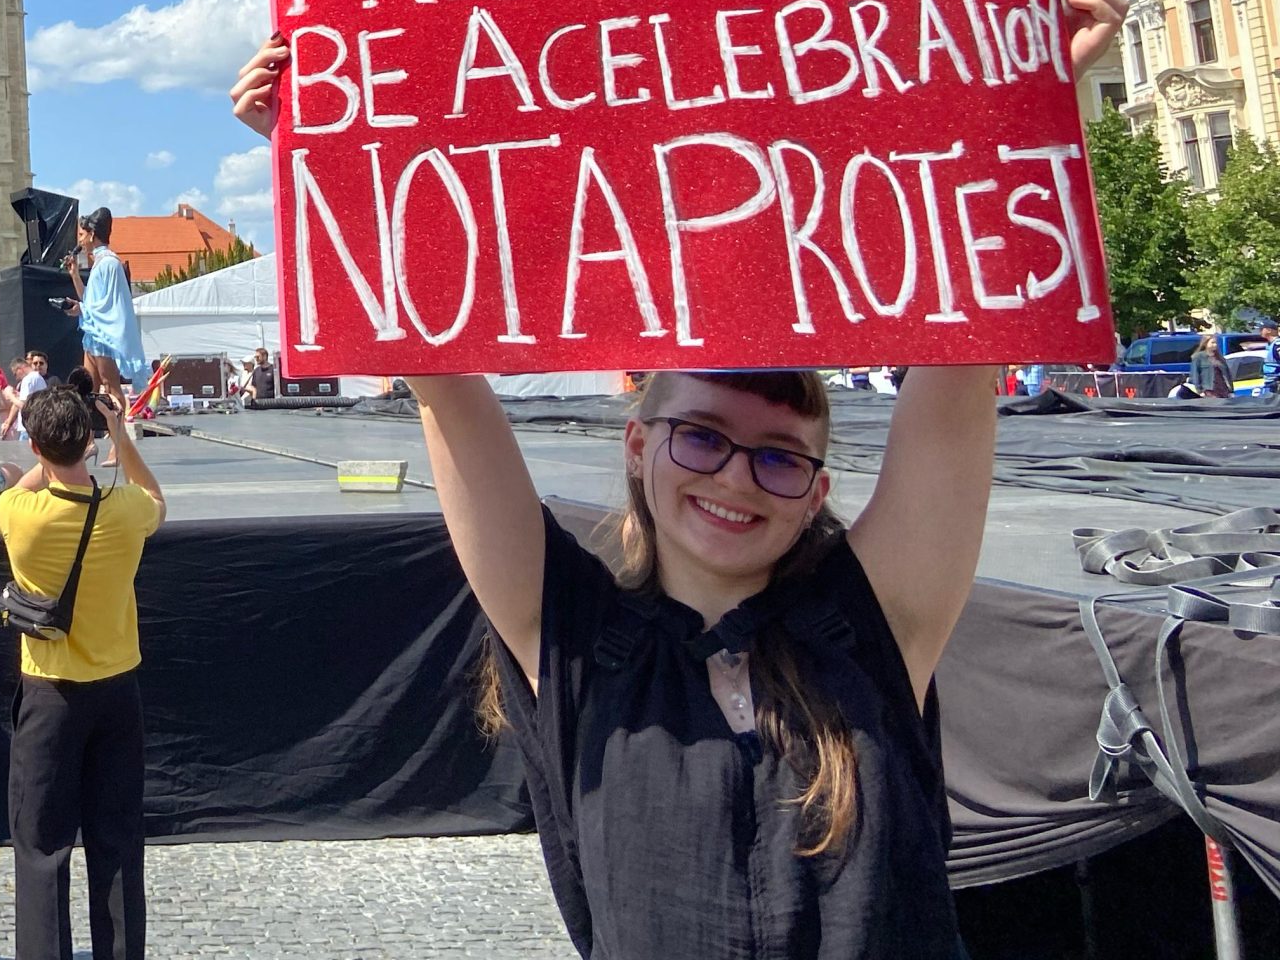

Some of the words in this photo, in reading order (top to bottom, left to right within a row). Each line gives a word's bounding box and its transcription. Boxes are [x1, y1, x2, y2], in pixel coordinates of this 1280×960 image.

[292, 24, 419, 134] BE
[444, 6, 542, 119] A
[292, 132, 562, 352] NOT
[557, 145, 670, 339] A
[653, 131, 1100, 347] PROTEST
